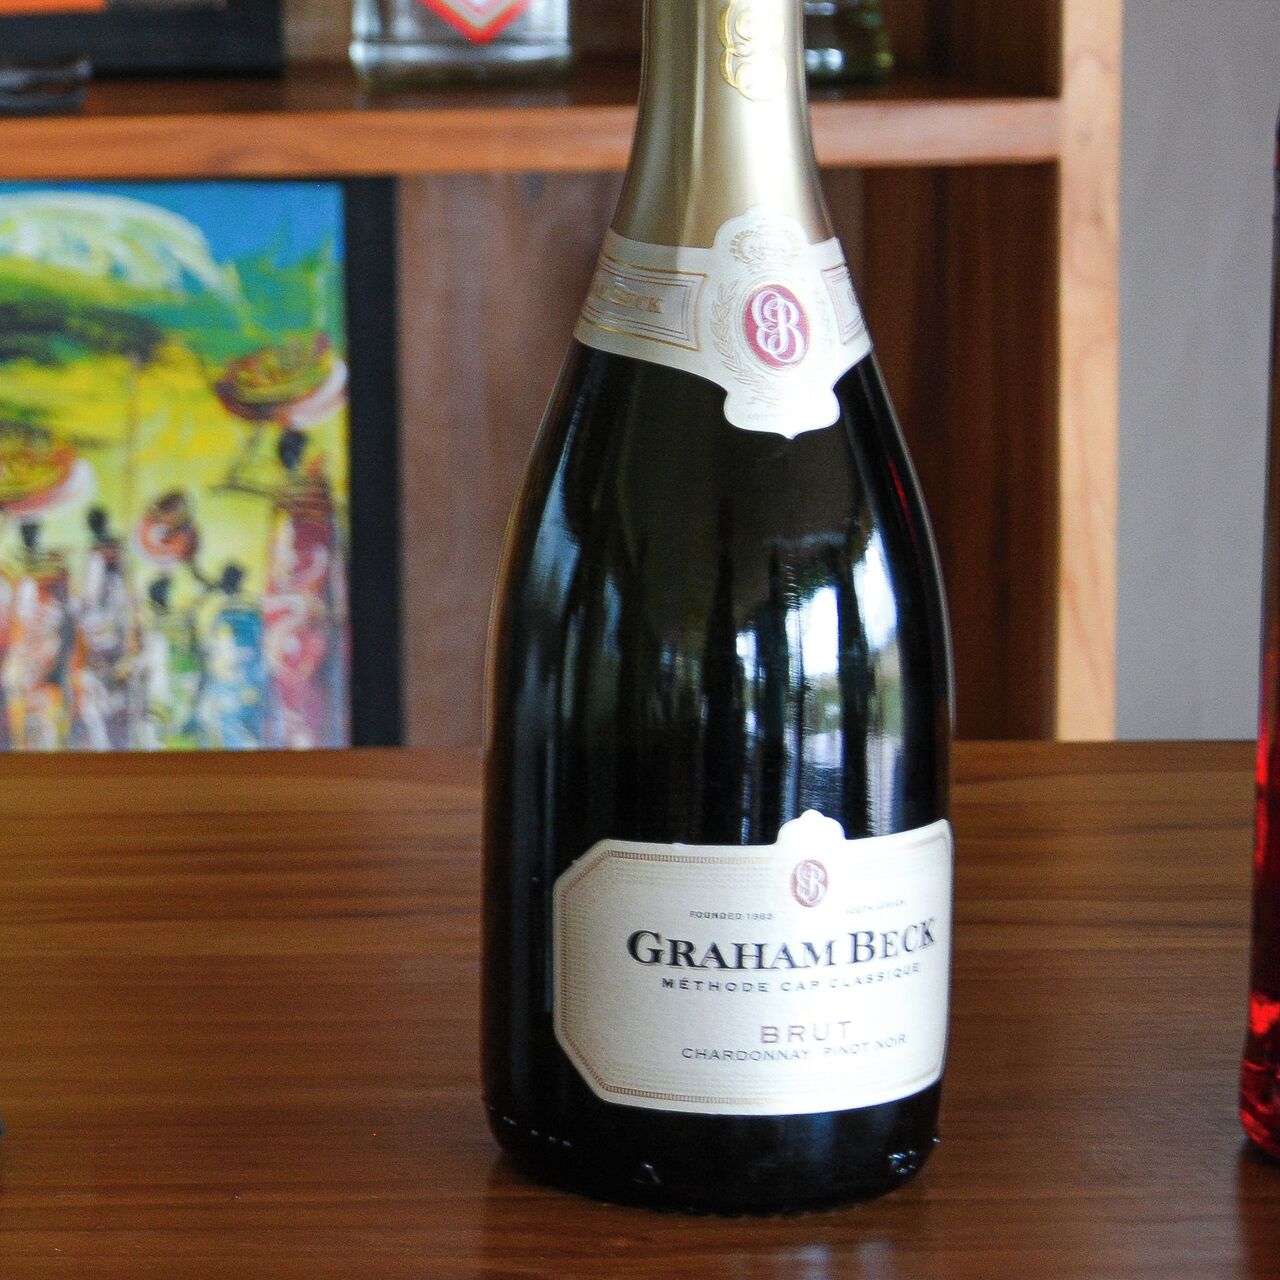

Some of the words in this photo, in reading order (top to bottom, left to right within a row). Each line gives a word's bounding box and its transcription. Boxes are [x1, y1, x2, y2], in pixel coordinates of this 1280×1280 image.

[689, 910, 741, 920] FOUNDED
[626, 929, 837, 970] GRAHAM
[846, 917, 935, 964] BECK
[661, 976, 769, 993] MÉTHODE
[780, 979, 820, 992] CAP
[829, 962, 921, 988] CLASSIQUE
[760, 1020, 852, 1044] BRUT
[681, 1046, 810, 1061] CHARDONNAY
[823, 1041, 868, 1057] PINOT
[875, 1033, 908, 1049] NOIR
